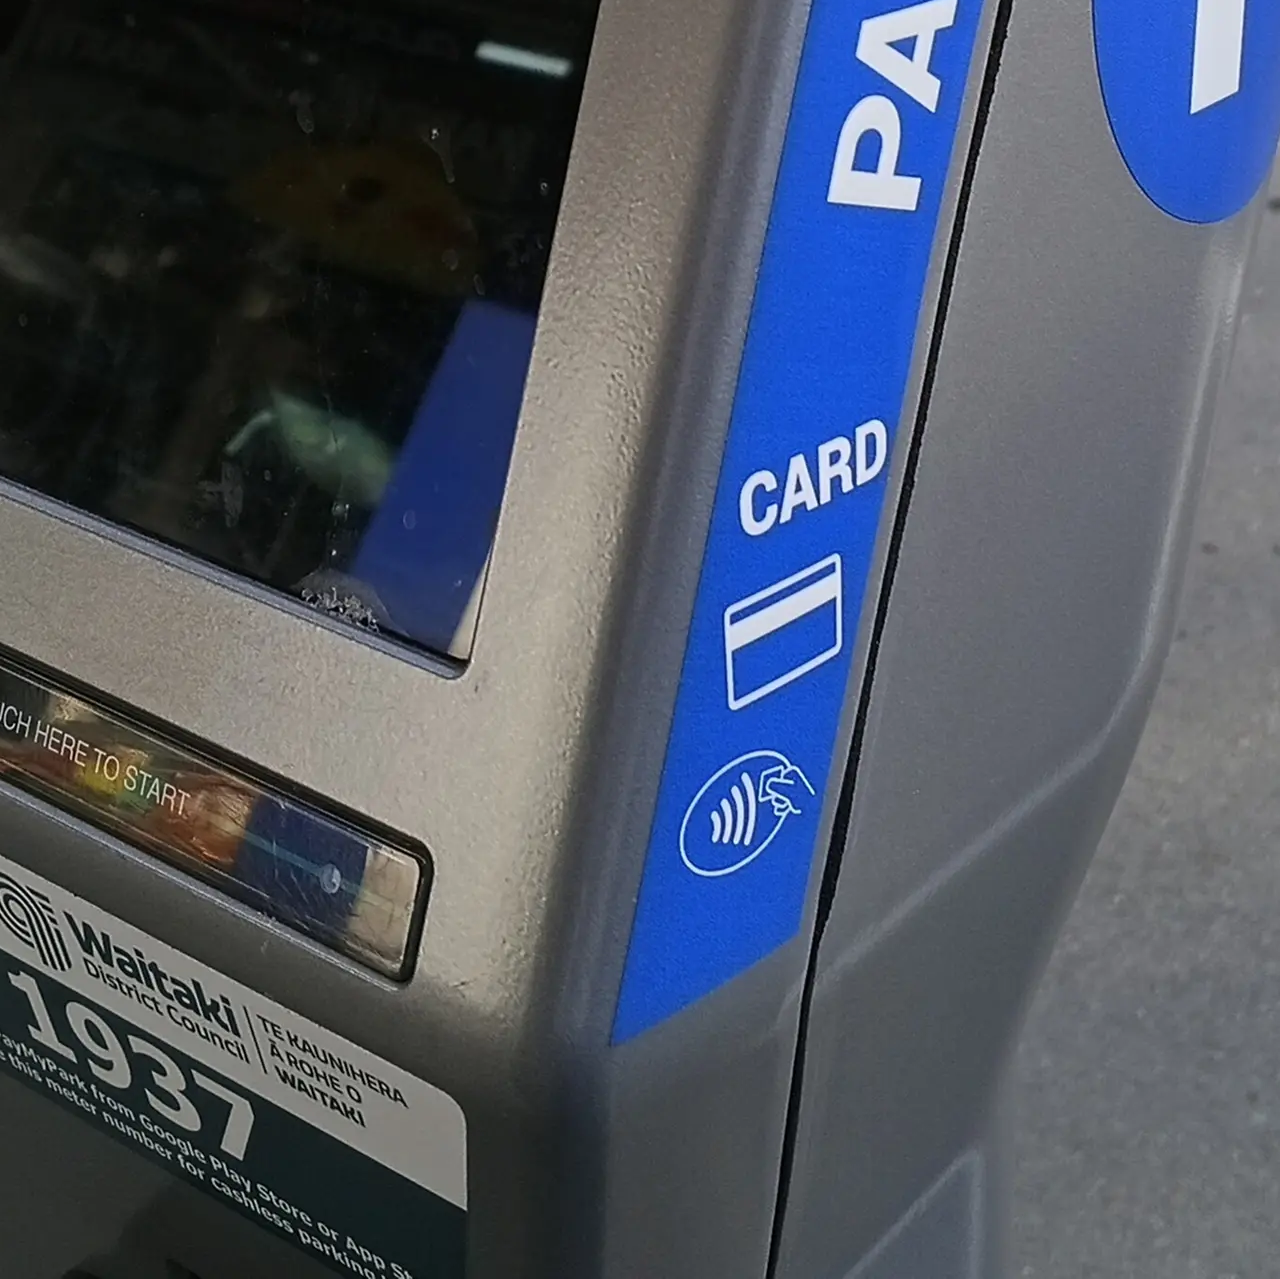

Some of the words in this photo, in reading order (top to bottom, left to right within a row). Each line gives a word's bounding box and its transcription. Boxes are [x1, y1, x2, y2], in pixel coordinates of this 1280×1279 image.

[738, 418, 888, 537] CARD
[34, 720, 90, 767] HERE
[93, 747, 120, 781] TO
[123, 765, 191, 816] START
[64, 910, 241, 1038] Waitaki
[83, 957, 163, 1016] District
[168, 1004, 250, 1064] Council
[7, 969, 255, 1161] 1937
[257, 1014, 284, 1042] TE
[287, 1029, 409, 1108] KAUNIHERA
[275, 1065, 366, 1128] WAITAKI
[286, 1054, 343, 1094] ROHE
[346, 1084, 362, 1105] O
[11, 1055, 42, 1082] this
[45, 1076, 97, 1115] meter
[103, 1112, 173, 1160] number
[177, 1154, 205, 1180] for
[211, 1177, 294, 1234] cashless
[90, 1084, 136, 1121] from
[139, 1114, 207, 1164] Google
[209, 1154, 251, 1193] Play
[256, 1183, 313, 1228] Store
[317, 1221, 339, 1241] or
[346, 1236, 386, 1270] App
